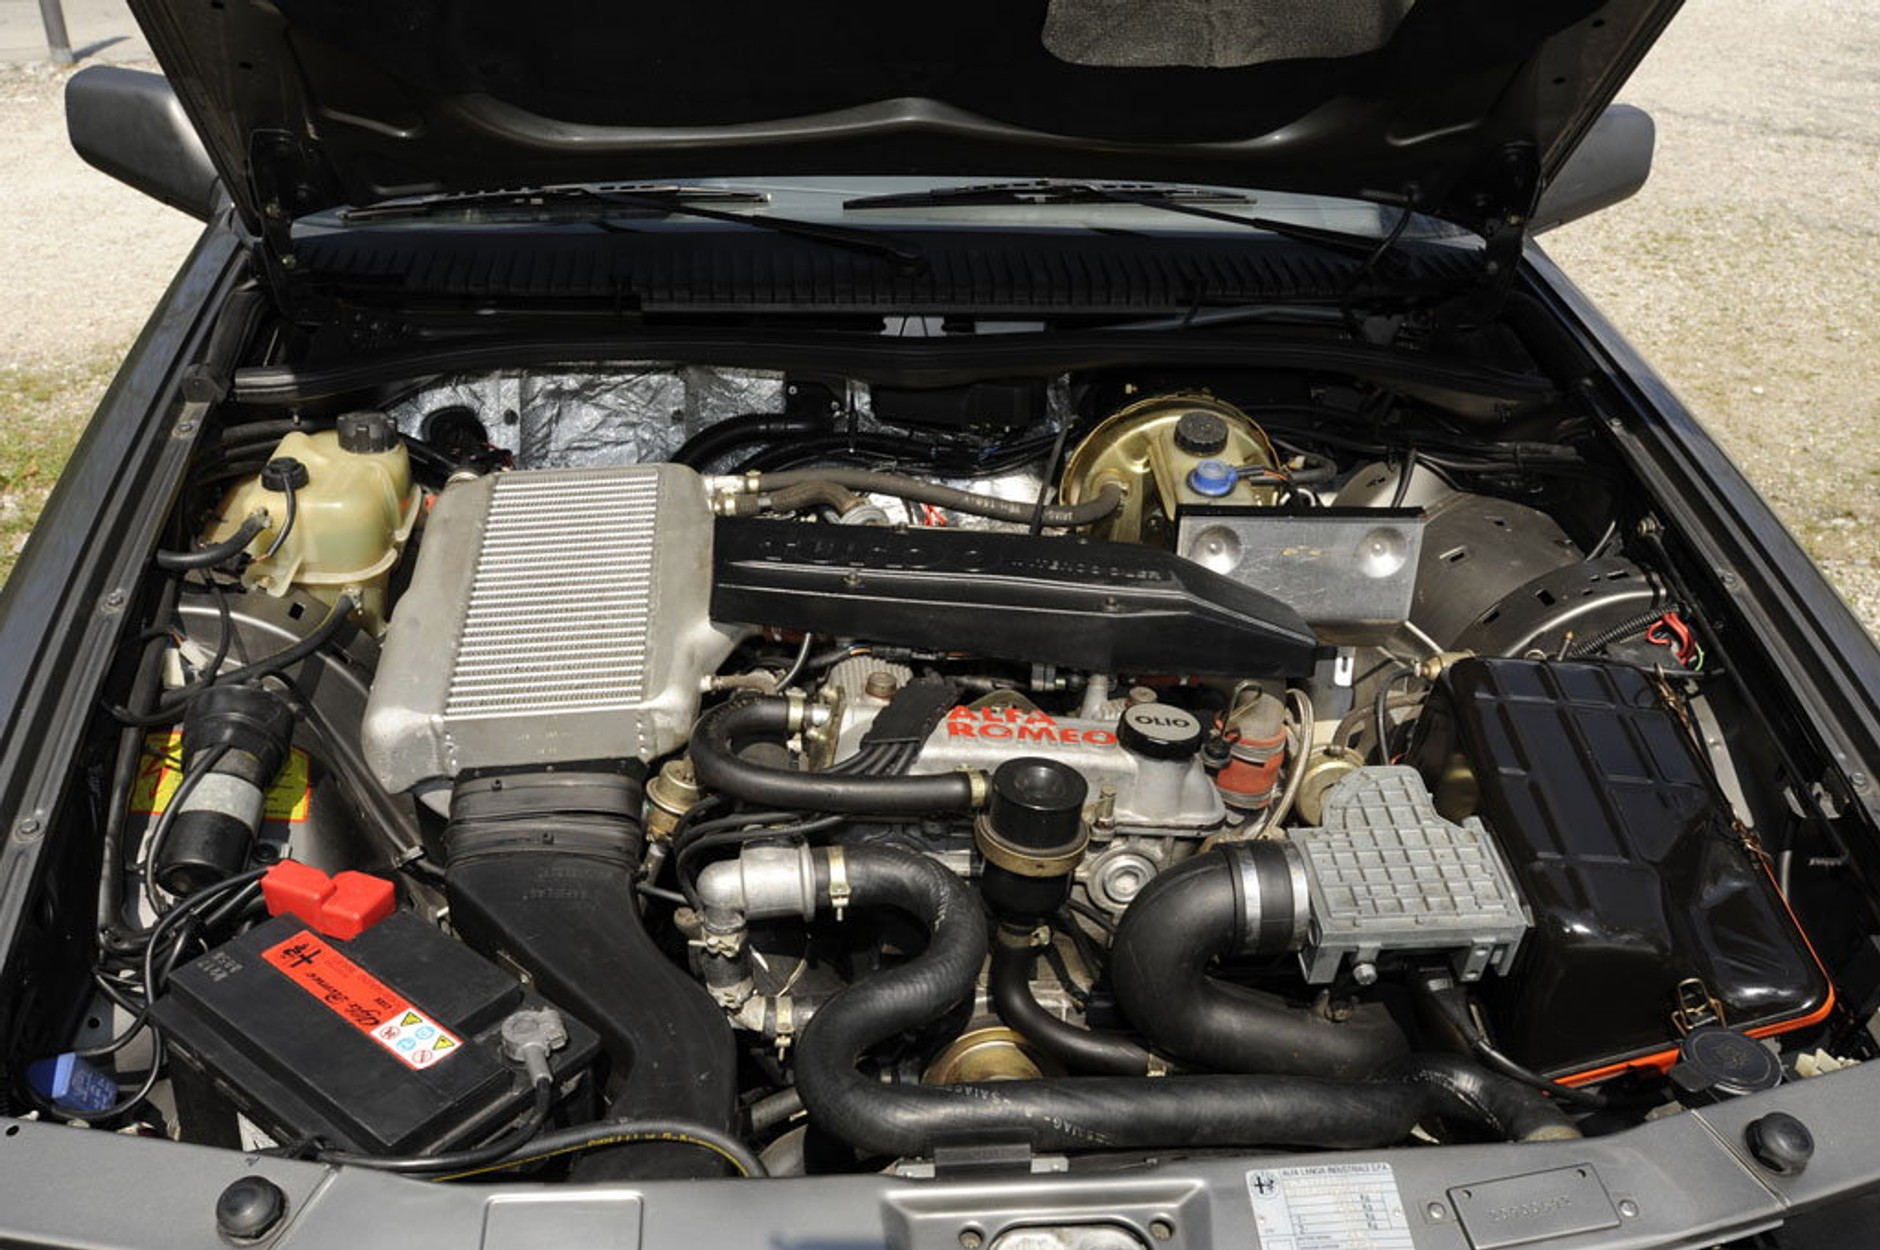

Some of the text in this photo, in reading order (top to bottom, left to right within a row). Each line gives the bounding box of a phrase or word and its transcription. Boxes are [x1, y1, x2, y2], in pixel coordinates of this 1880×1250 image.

[947, 704, 1057, 726] ALFA
[1134, 715, 1191, 729] OLIO
[947, 722, 1118, 745] ROMEO
